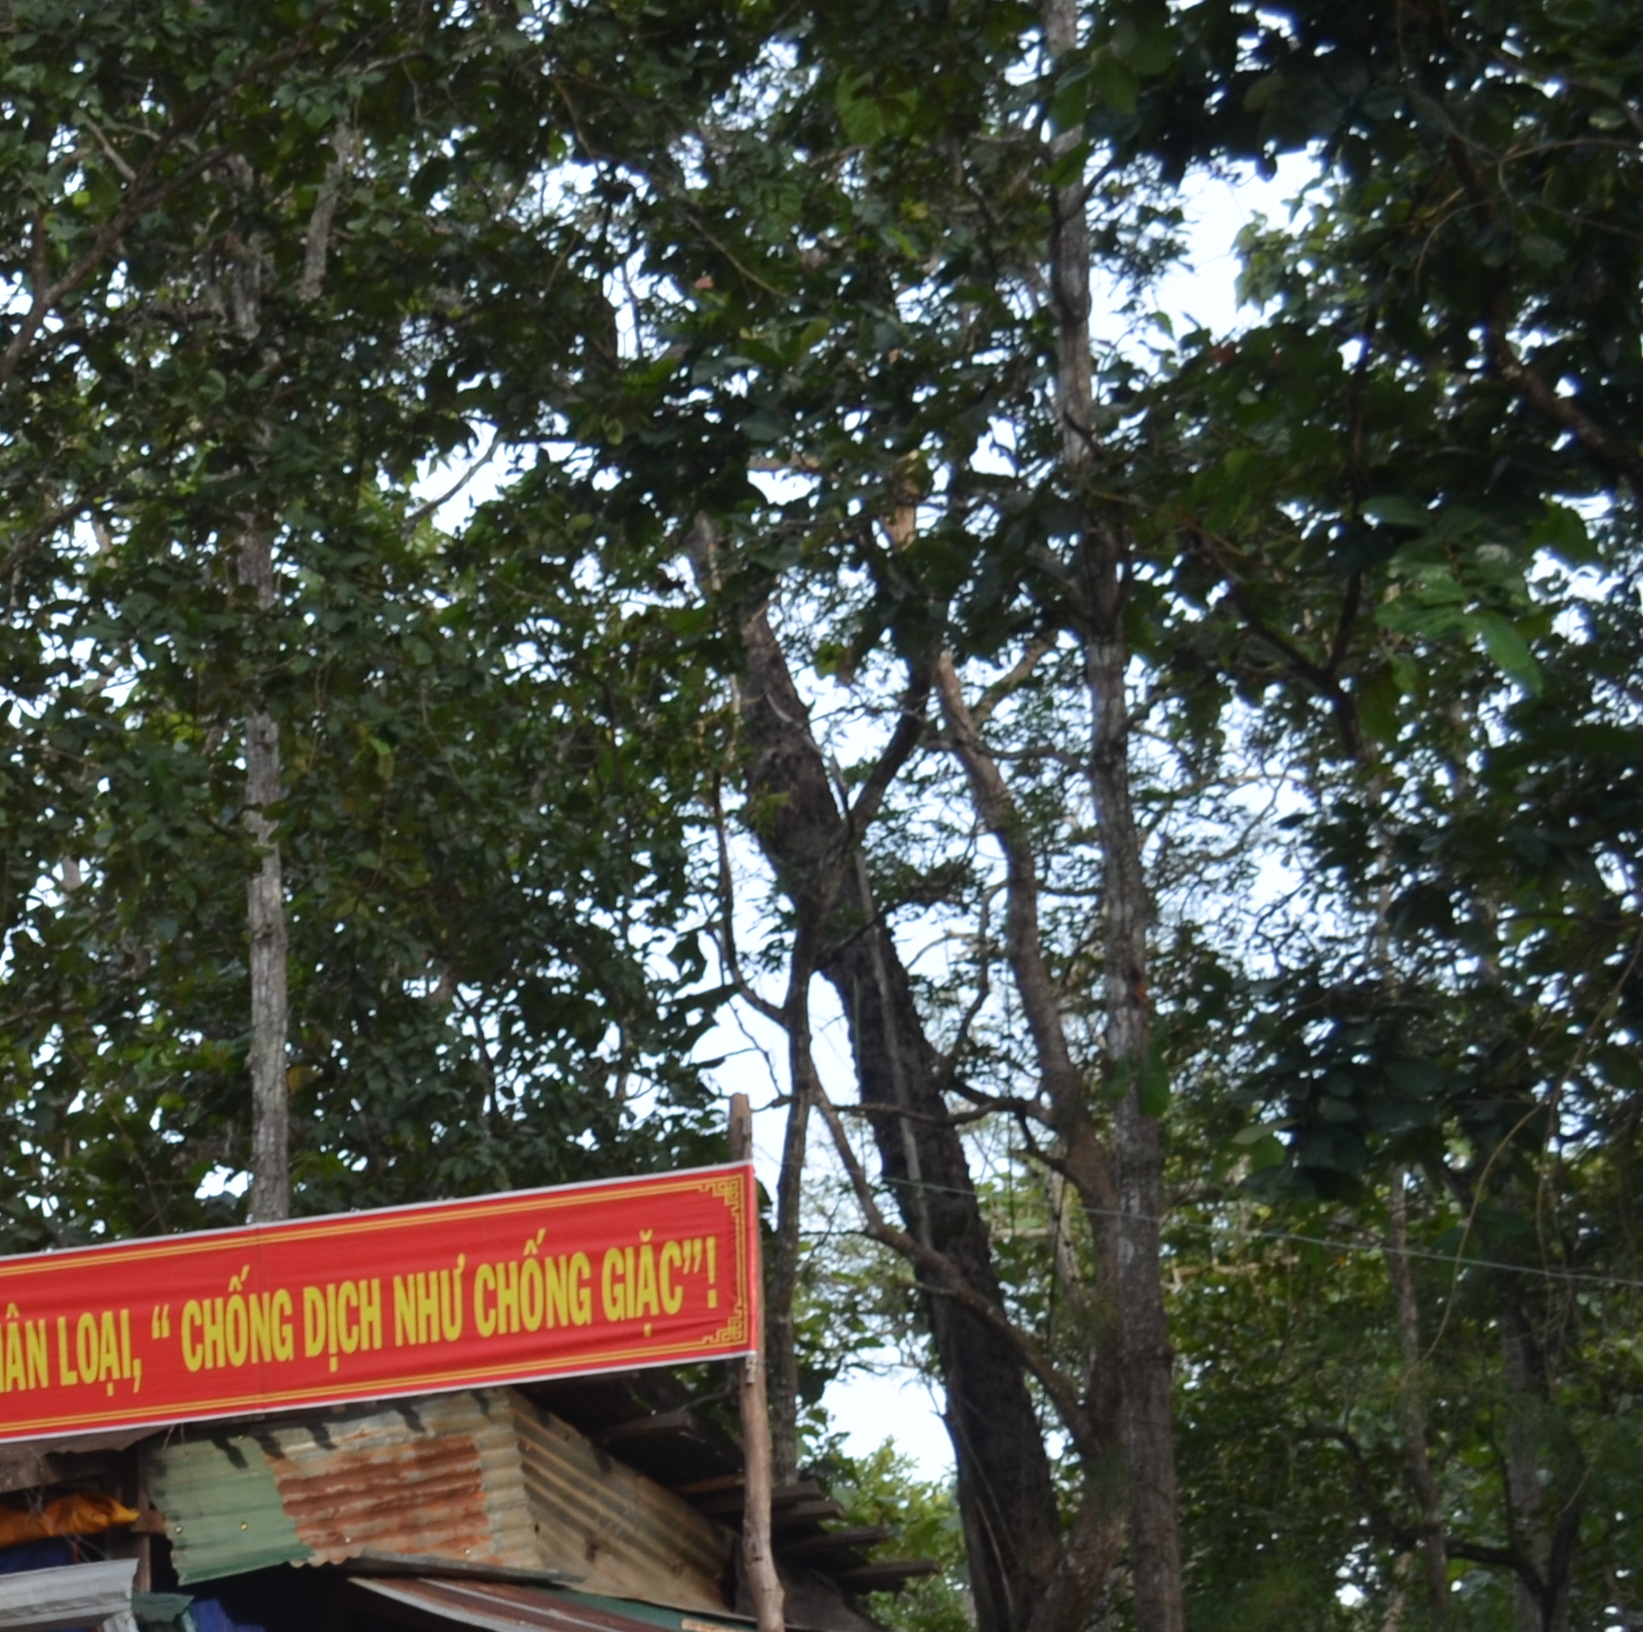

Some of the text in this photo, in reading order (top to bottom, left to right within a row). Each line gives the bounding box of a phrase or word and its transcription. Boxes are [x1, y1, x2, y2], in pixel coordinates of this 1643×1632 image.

[58, 1309, 143, 1396] LOẠI,
[304, 1278, 382, 1373] DỊCH
[394, 1253, 466, 1346] NHƯ
[474, 1228, 593, 1338] CHỐNG
